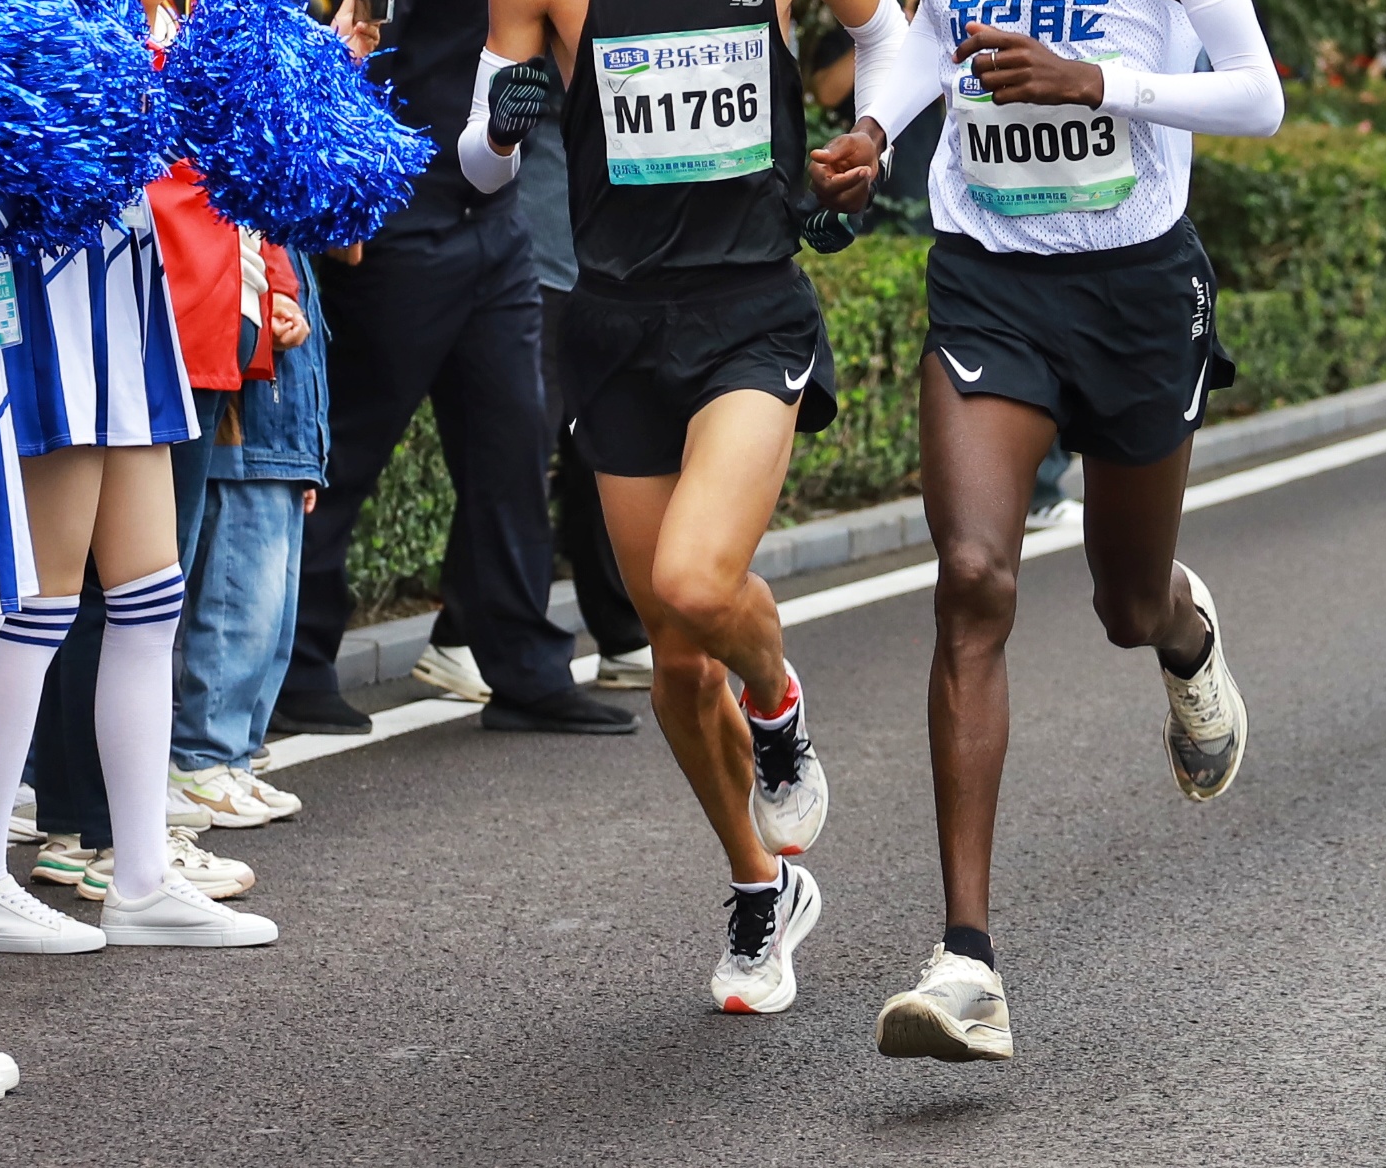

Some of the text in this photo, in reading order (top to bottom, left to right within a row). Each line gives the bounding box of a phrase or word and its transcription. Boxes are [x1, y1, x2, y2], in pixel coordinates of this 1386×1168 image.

[608, 50, 645, 64] 君乐宝
[653, 39, 764, 70] 君乐宝集团
[613, 83, 758, 134] M1766
[967, 115, 1116, 164] M0003
